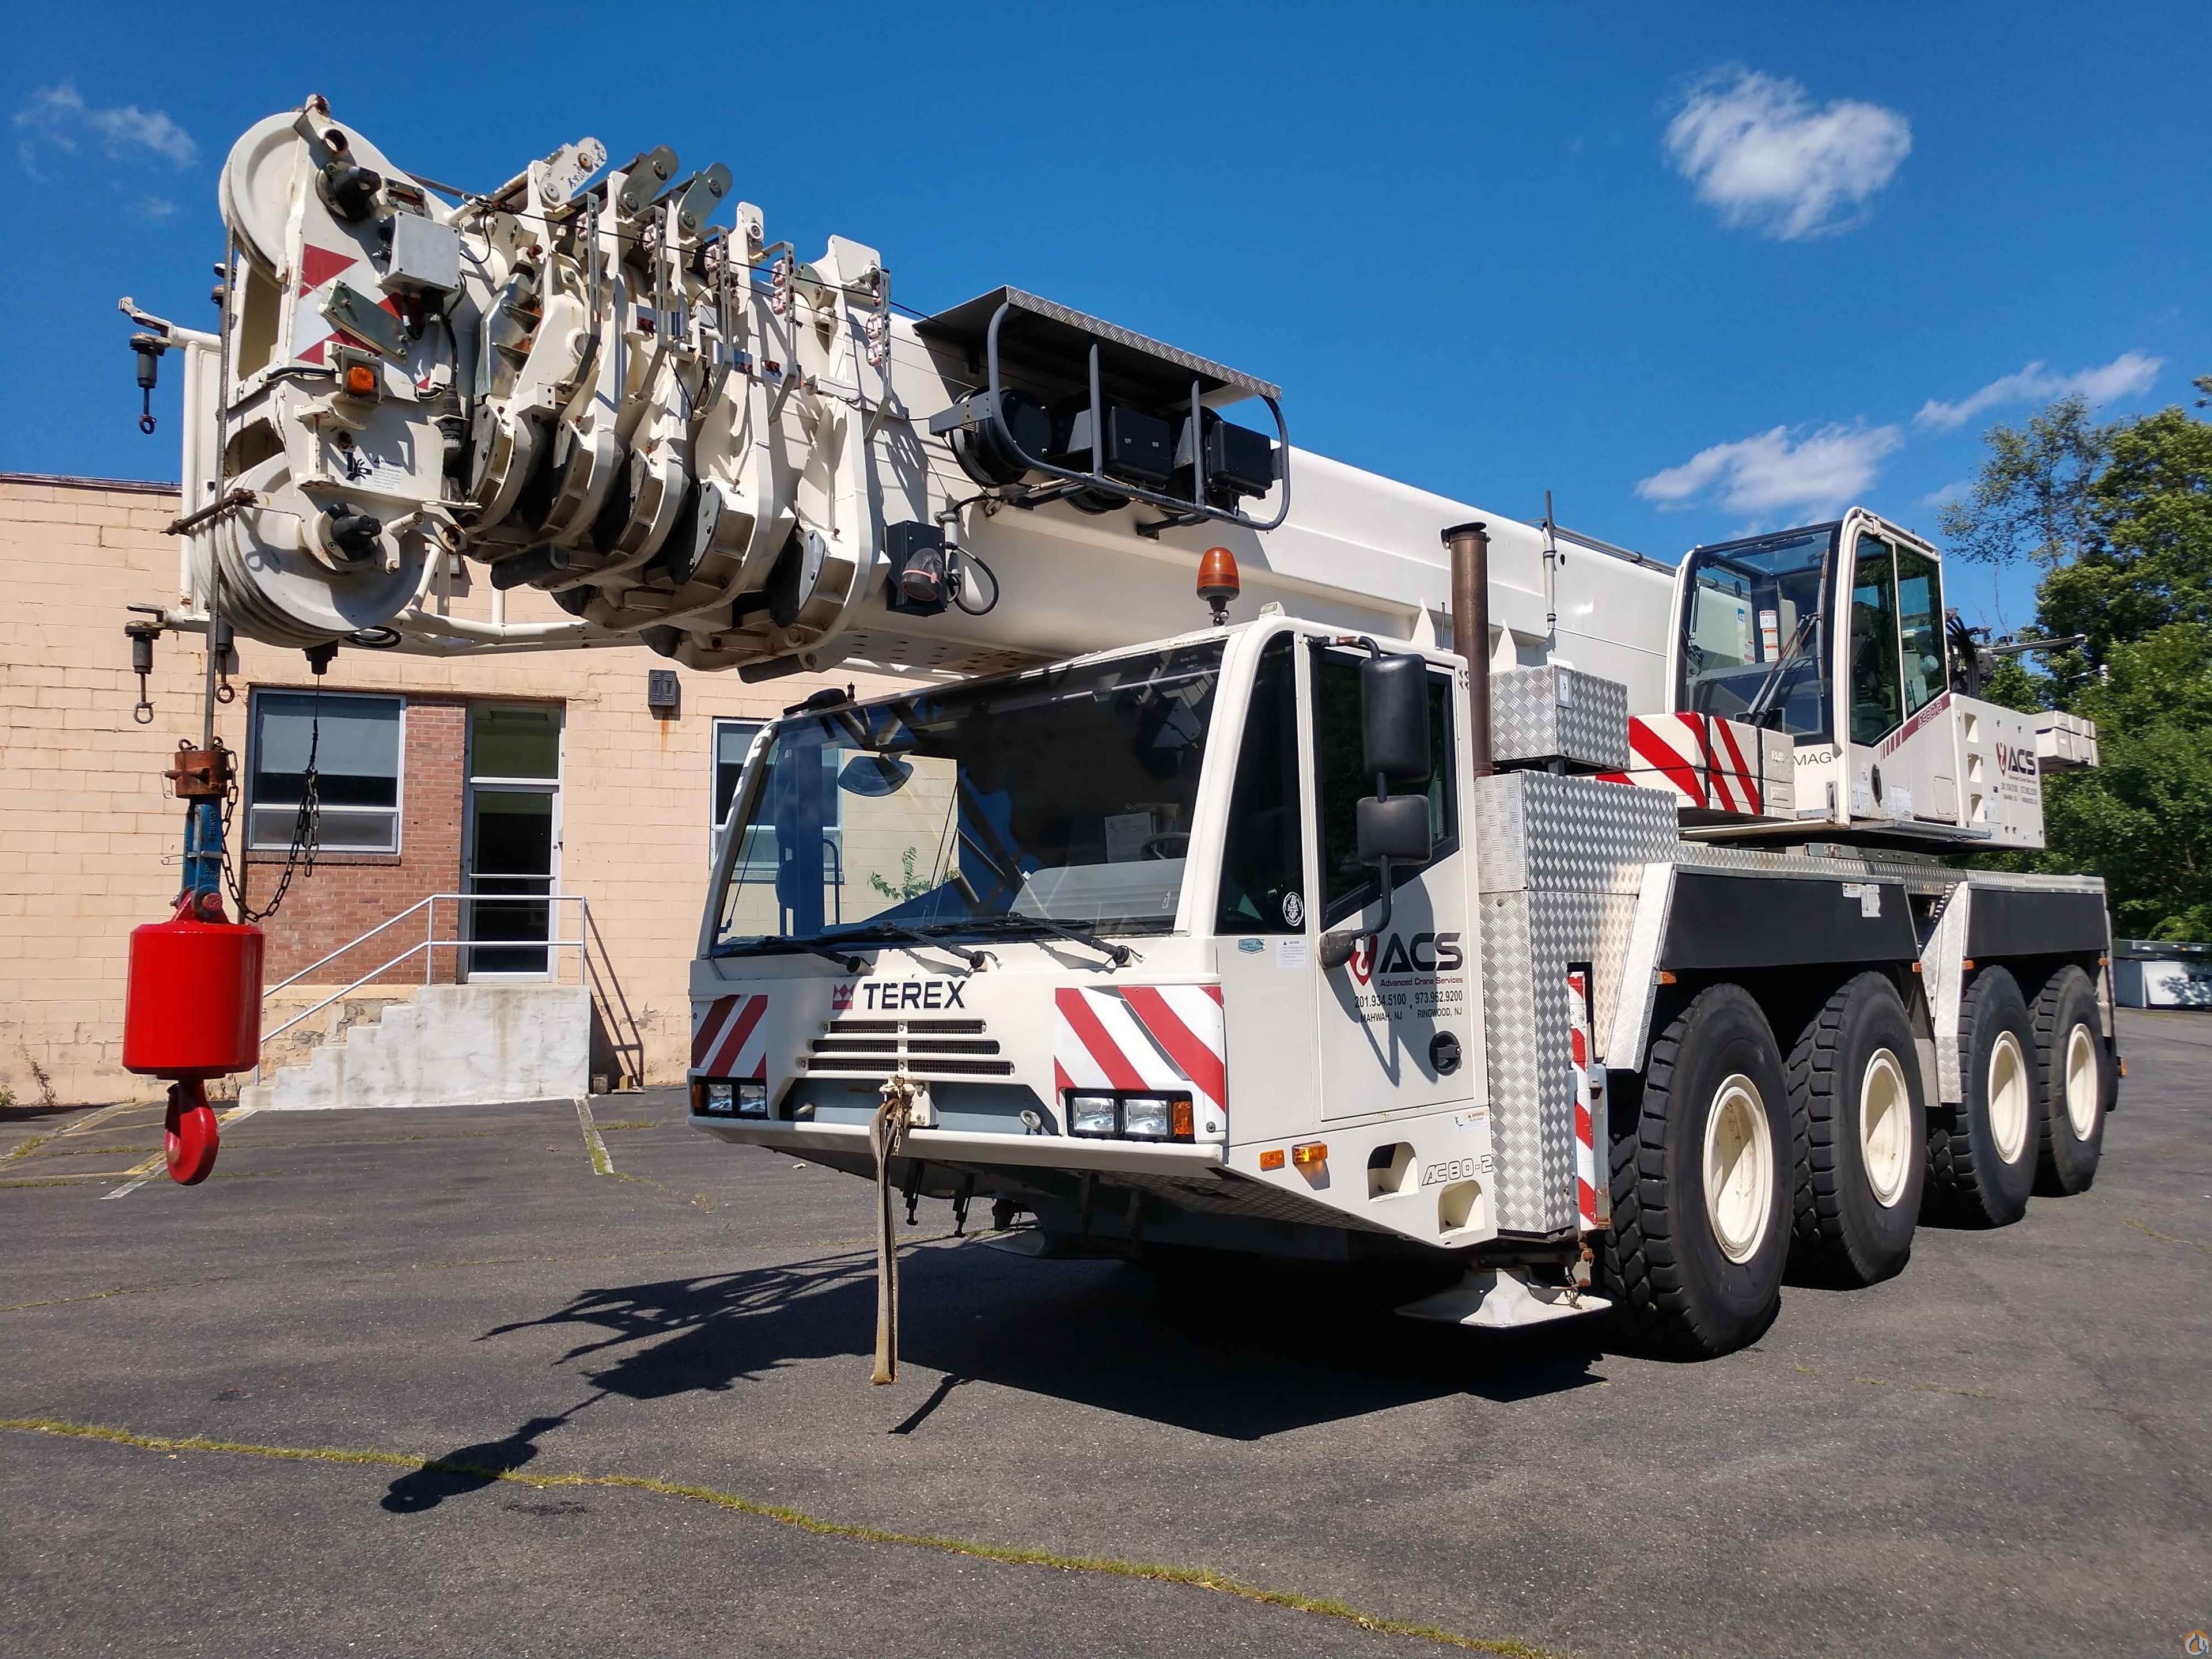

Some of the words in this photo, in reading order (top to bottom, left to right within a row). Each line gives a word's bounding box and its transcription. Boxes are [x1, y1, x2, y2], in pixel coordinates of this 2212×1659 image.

[2008, 747, 2036, 775] ACS
[1378, 933, 1463, 974] ACS
[1380, 979, 1412, 987] Advanced
[1415, 978, 1434, 986] Crane
[1435, 976, 1463, 984] Services
[863, 980, 967, 1009] TEREX
[1355, 993, 1406, 1008] 201.934.5100
[1415, 990, 1463, 1005] 973.962.9200
[1360, 1012, 1392, 1023] MAHWAH,
[1394, 1011, 1403, 1021] NJ
[1417, 1007, 1452, 1018] RINGWOOD,
[1455, 1007, 1463, 1016] NJ
